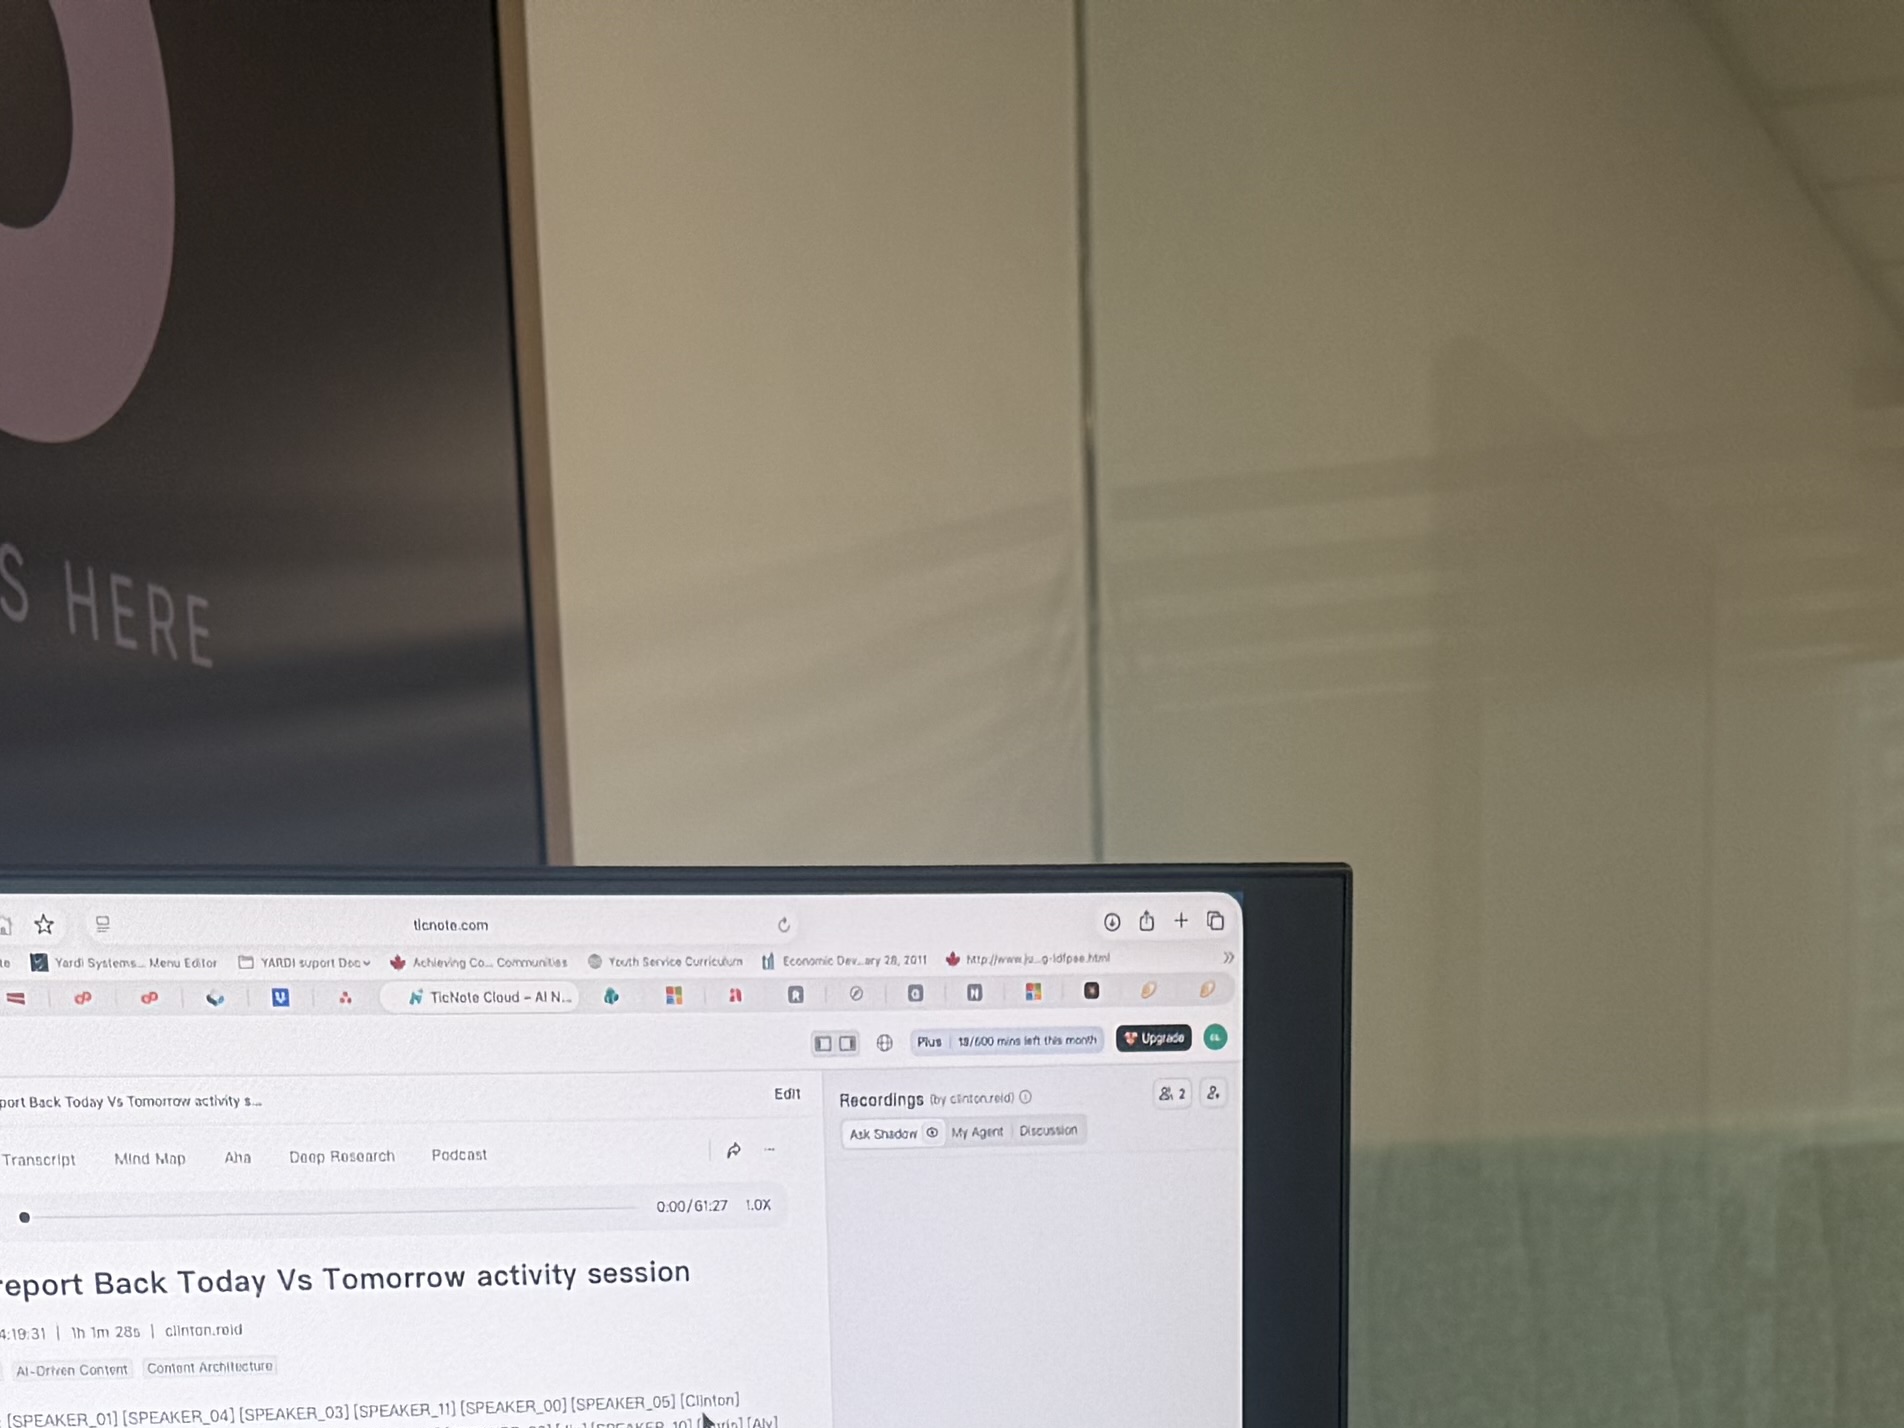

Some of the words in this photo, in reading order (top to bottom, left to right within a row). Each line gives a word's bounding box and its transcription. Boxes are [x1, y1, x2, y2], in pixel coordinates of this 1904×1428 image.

[64, 560, 214, 668] HERE
[413, 918, 489, 931] ticnote.com
[917, 1036, 942, 1048] Plus
[1141, 1032, 1185, 1046] Upgrade
[774, 1087, 801, 1101] Edit
[839, 1092, 924, 1110] Recordings
[29, 1096, 62, 1109] Back
[64, 1095, 104, 1111] Today
[107, 1095, 124, 1108] Vs
[126, 1095, 191, 1108] Tomorrow
[195, 1094, 241, 1109] activity
[849, 1128, 871, 1141] Ask
[873, 1128, 918, 1140] Shadow
[951, 1127, 968, 1141] My
[971, 1126, 1004, 1141] Agent
[1019, 1124, 1078, 1137] Discussion
[1, 1153, 76, 1168] Transcript
[114, 1152, 150, 1165] Mind
[155, 1152, 186, 1167] Map
[224, 1151, 252, 1164] Aha
[289, 1150, 326, 1166] Deep
[330, 1149, 396, 1163] Research
[431, 1148, 487, 1162] Podcast
[94, 1270, 168, 1295] Back
[176, 1269, 266, 1299] Today
[276, 1268, 313, 1291] Vs
[322, 1267, 466, 1291] Tomorrow
[477, 1262, 577, 1291] activity
[588, 1260, 690, 1284] session
[71, 1326, 86, 1339] 1h
[90, 1326, 110, 1339] 1m
[115, 1325, 141, 1338] 28s
[165, 1323, 243, 1338] clinton.reid
[16, 1365, 76, 1377] AI-Driven
[79, 1364, 128, 1376] Content
[147, 1362, 195, 1375] Content
[199, 1361, 273, 1373] Architecture
[122, 1406, 235, 1428] [SPEAKER_04]
[239, 1403, 350, 1424] [SPEAKER_03]
[353, 1400, 457, 1421] [SPEAKER_11]
[460, 1396, 567, 1417] [SPEAKER_00]
[570, 1393, 676, 1414] [SPEAKER_05]
